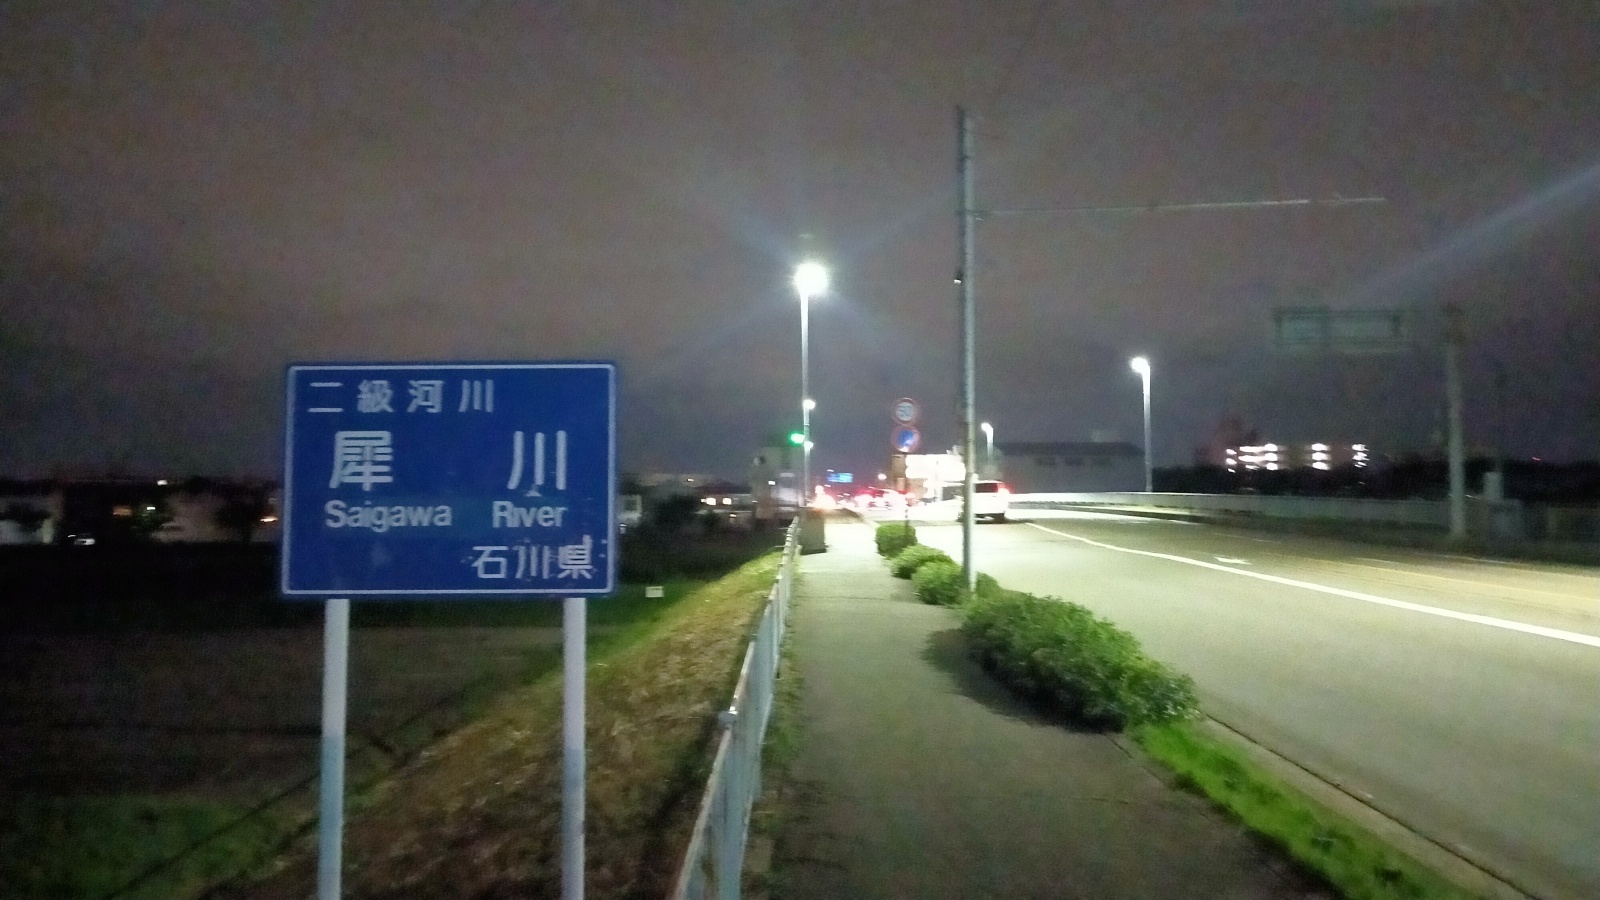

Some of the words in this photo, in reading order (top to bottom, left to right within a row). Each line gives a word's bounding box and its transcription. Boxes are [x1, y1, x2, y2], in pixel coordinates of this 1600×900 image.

[308, 379, 494, 413] 二級河川
[324, 499, 452, 532] Saigawa
[492, 500, 567, 528] River
[472, 534, 593, 579] 石川県
